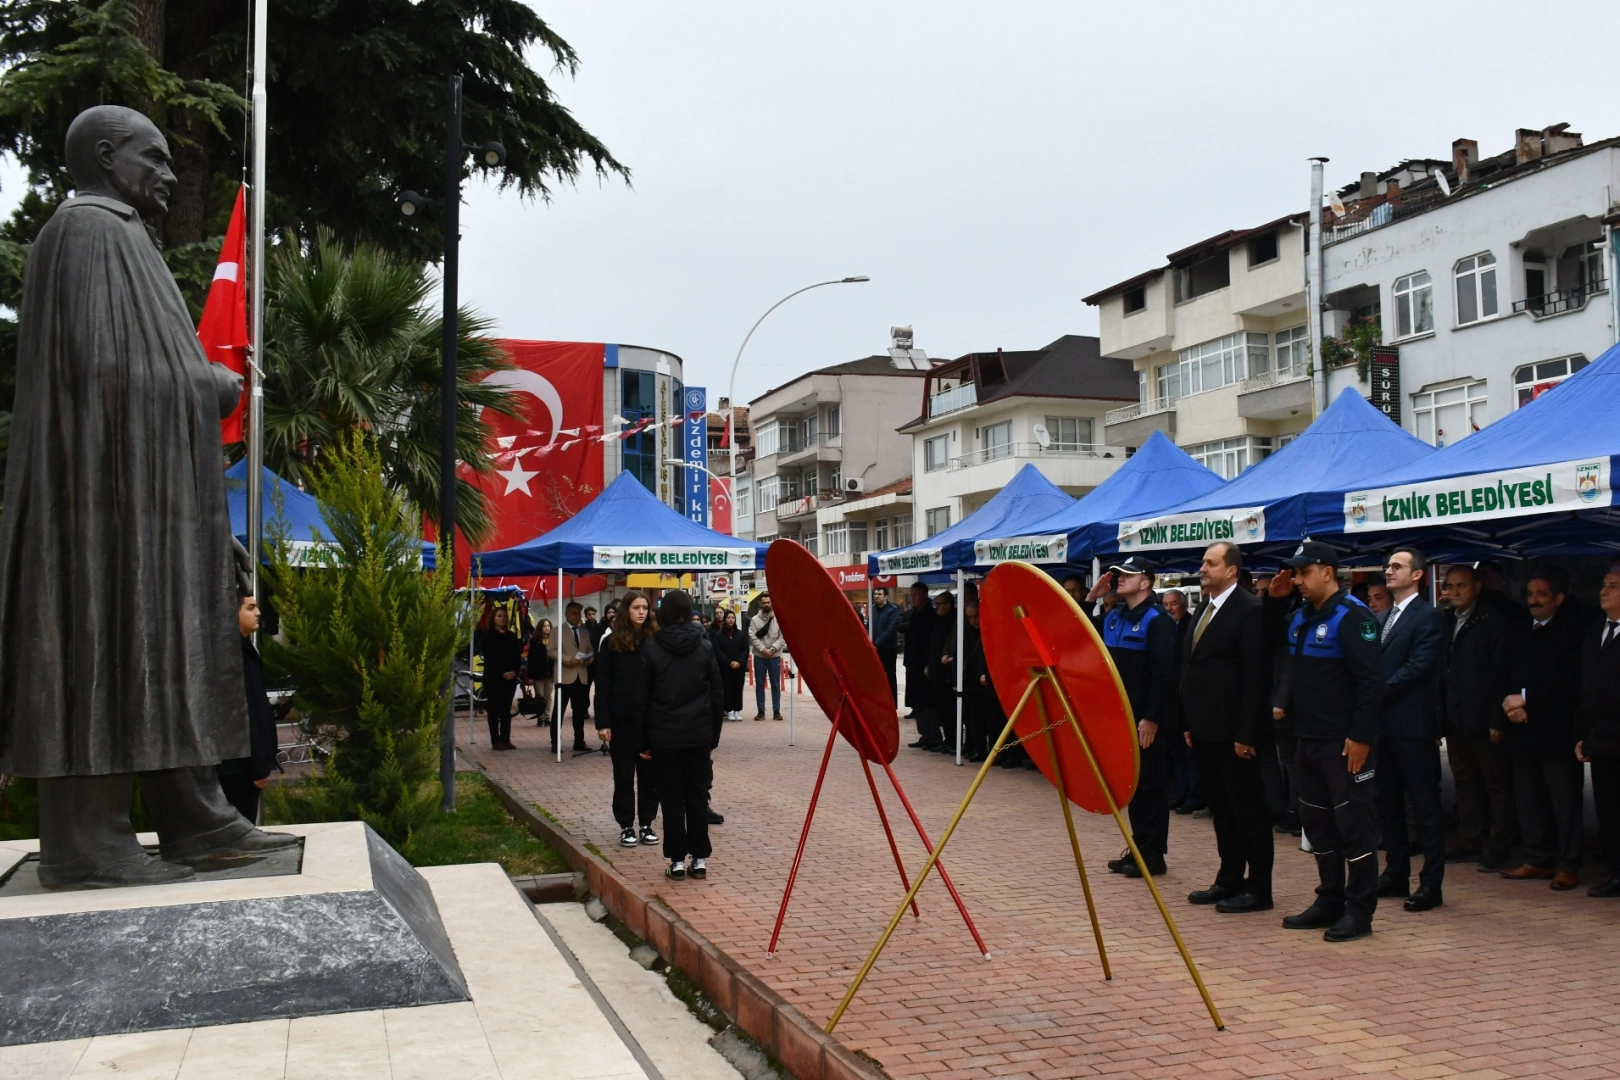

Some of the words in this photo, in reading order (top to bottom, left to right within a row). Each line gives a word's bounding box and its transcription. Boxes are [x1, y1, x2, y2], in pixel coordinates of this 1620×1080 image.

[1381, 368, 1391, 419] SÜRÜ
[1382, 491, 1432, 523] İZNİK
[1435, 472, 1554, 517] BELEDİYESİ
[1139, 522, 1168, 545] İZNİK
[1170, 515, 1234, 542] BELEDİYESİ
[623, 550, 657, 565] İZNİK
[660, 550, 728, 565] BELEDİYESİ
[988, 543, 1008, 560] İZNİK
[1008, 541, 1049, 560] BELEDİYESİ
[845, 573, 865, 582] vodafone
